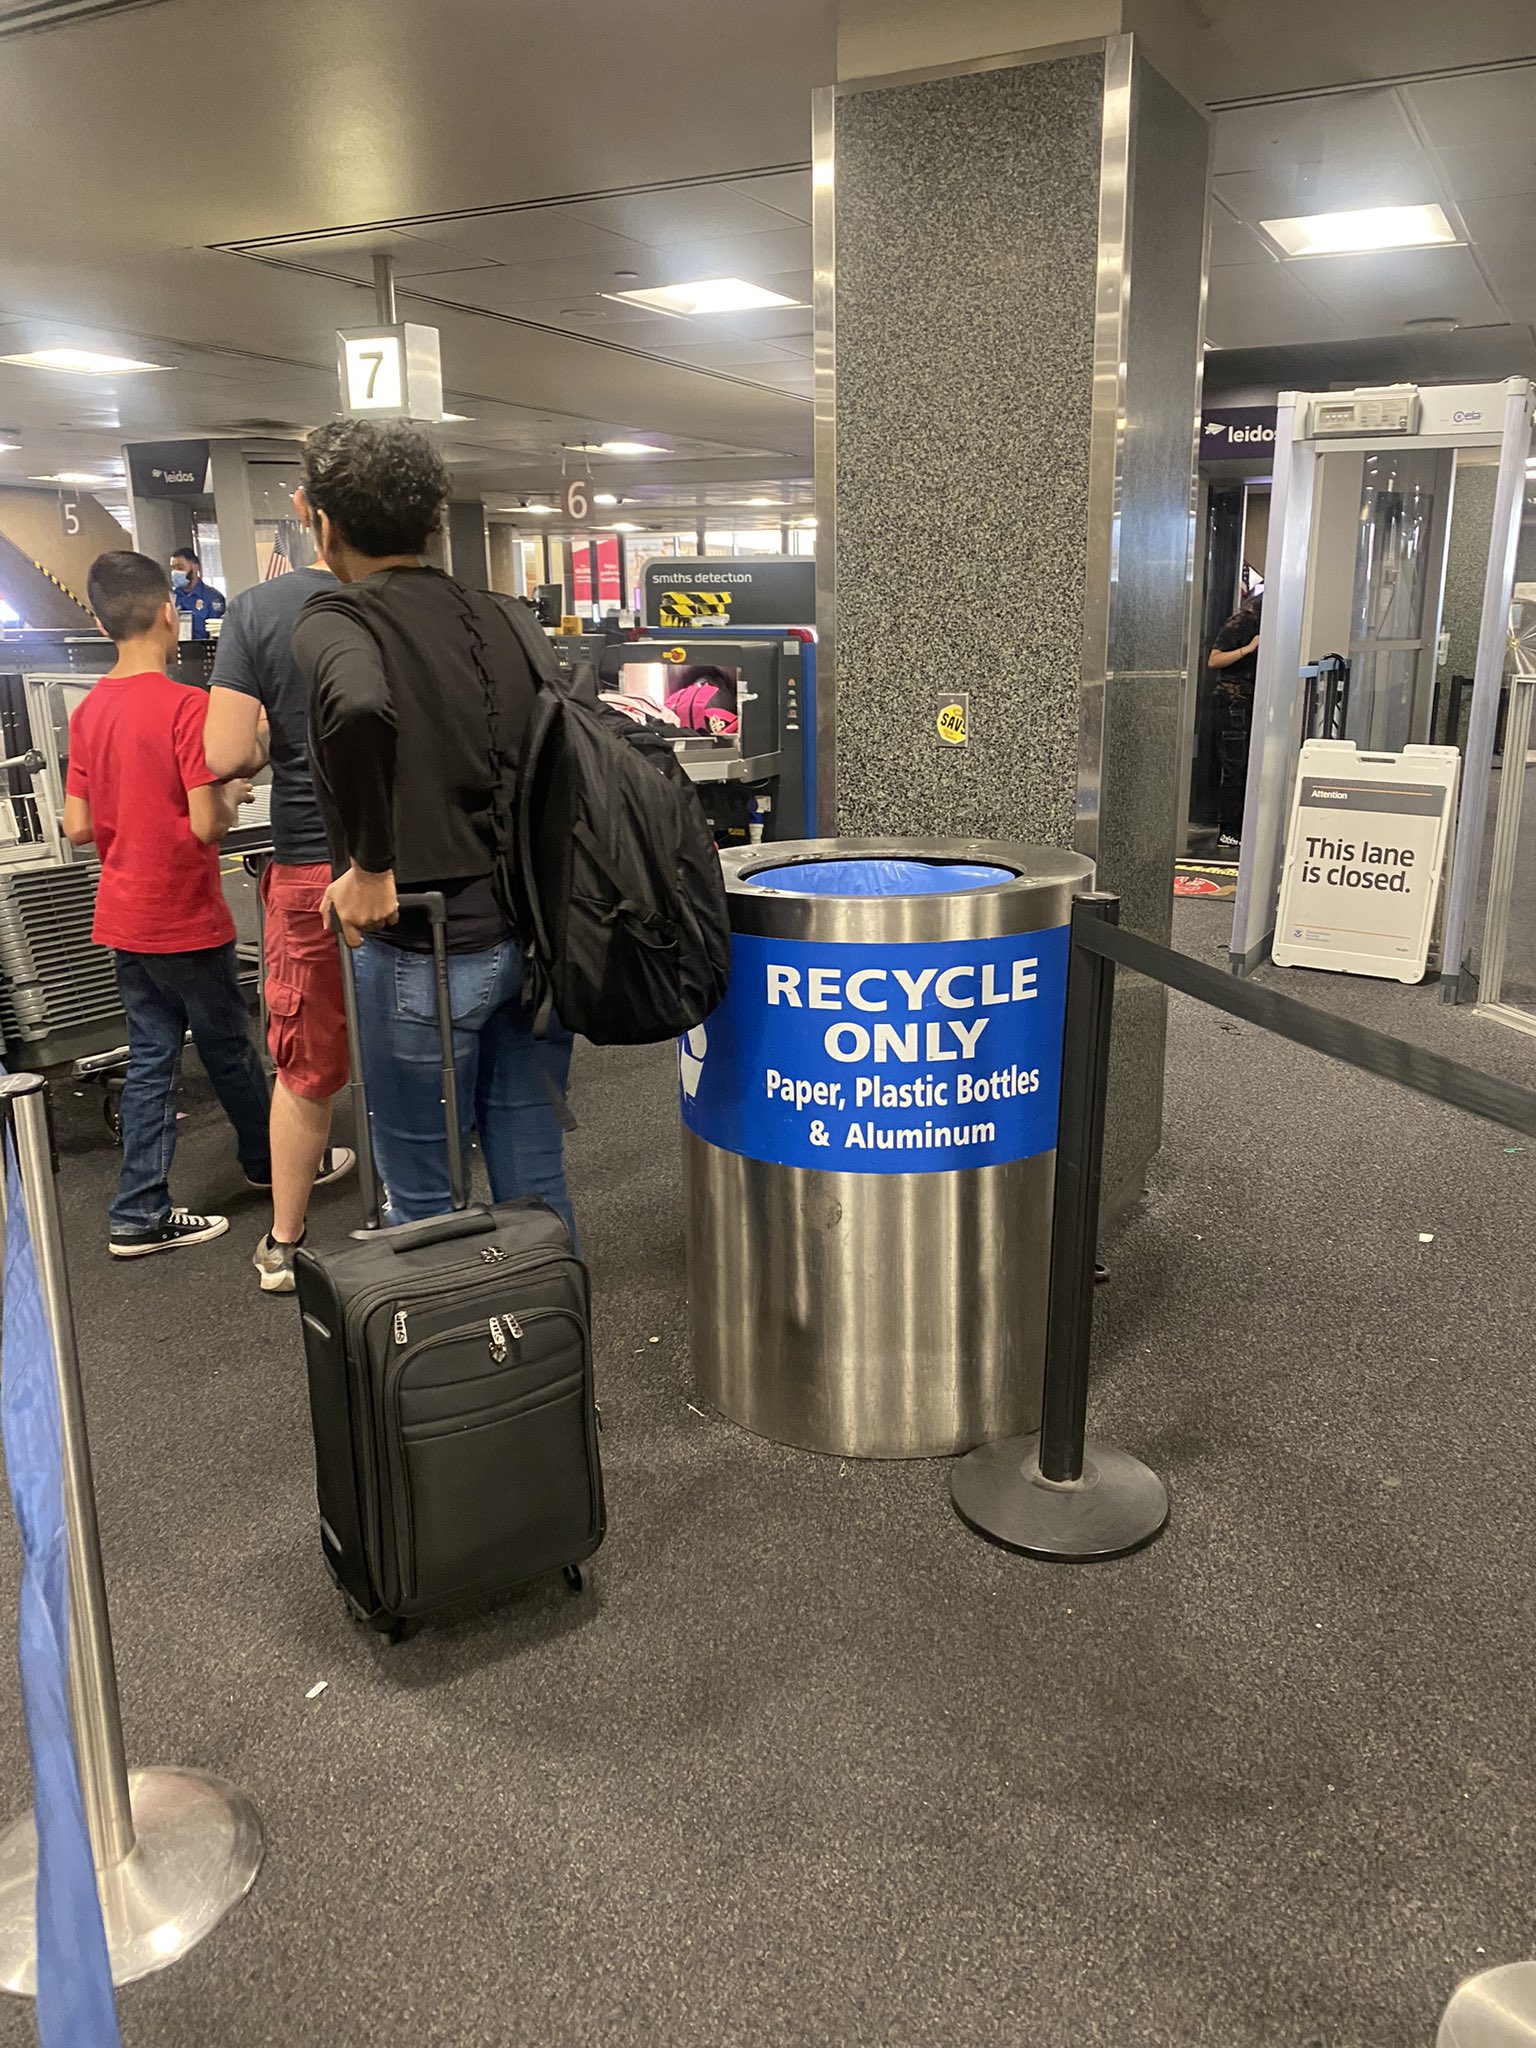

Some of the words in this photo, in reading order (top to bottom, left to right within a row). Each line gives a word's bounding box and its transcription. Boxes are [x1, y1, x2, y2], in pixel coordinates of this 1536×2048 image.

[359, 351, 383, 399] 7
[163, 470, 195, 483] leidos
[567, 481, 587, 519] 6
[64, 503, 80, 534] 5
[652, 573, 692, 584] smiths
[694, 572, 752, 583] detection
[1311, 789, 1348, 800] Attention
[1306, 837, 1355, 862] This
[1361, 841, 1415, 867] lane
[1302, 861, 1321, 884] is
[1327, 865, 1411, 894] closed.
[766, 957, 1038, 1012] RECYCLE
[823, 1018, 990, 1063] ONLY
[766, 1069, 846, 1111] Paper,
[855, 1075, 948, 1109] Plastic
[957, 1064, 1040, 1104] Bottles
[809, 1120, 831, 1148] &
[844, 1120, 996, 1150] Aluminum
